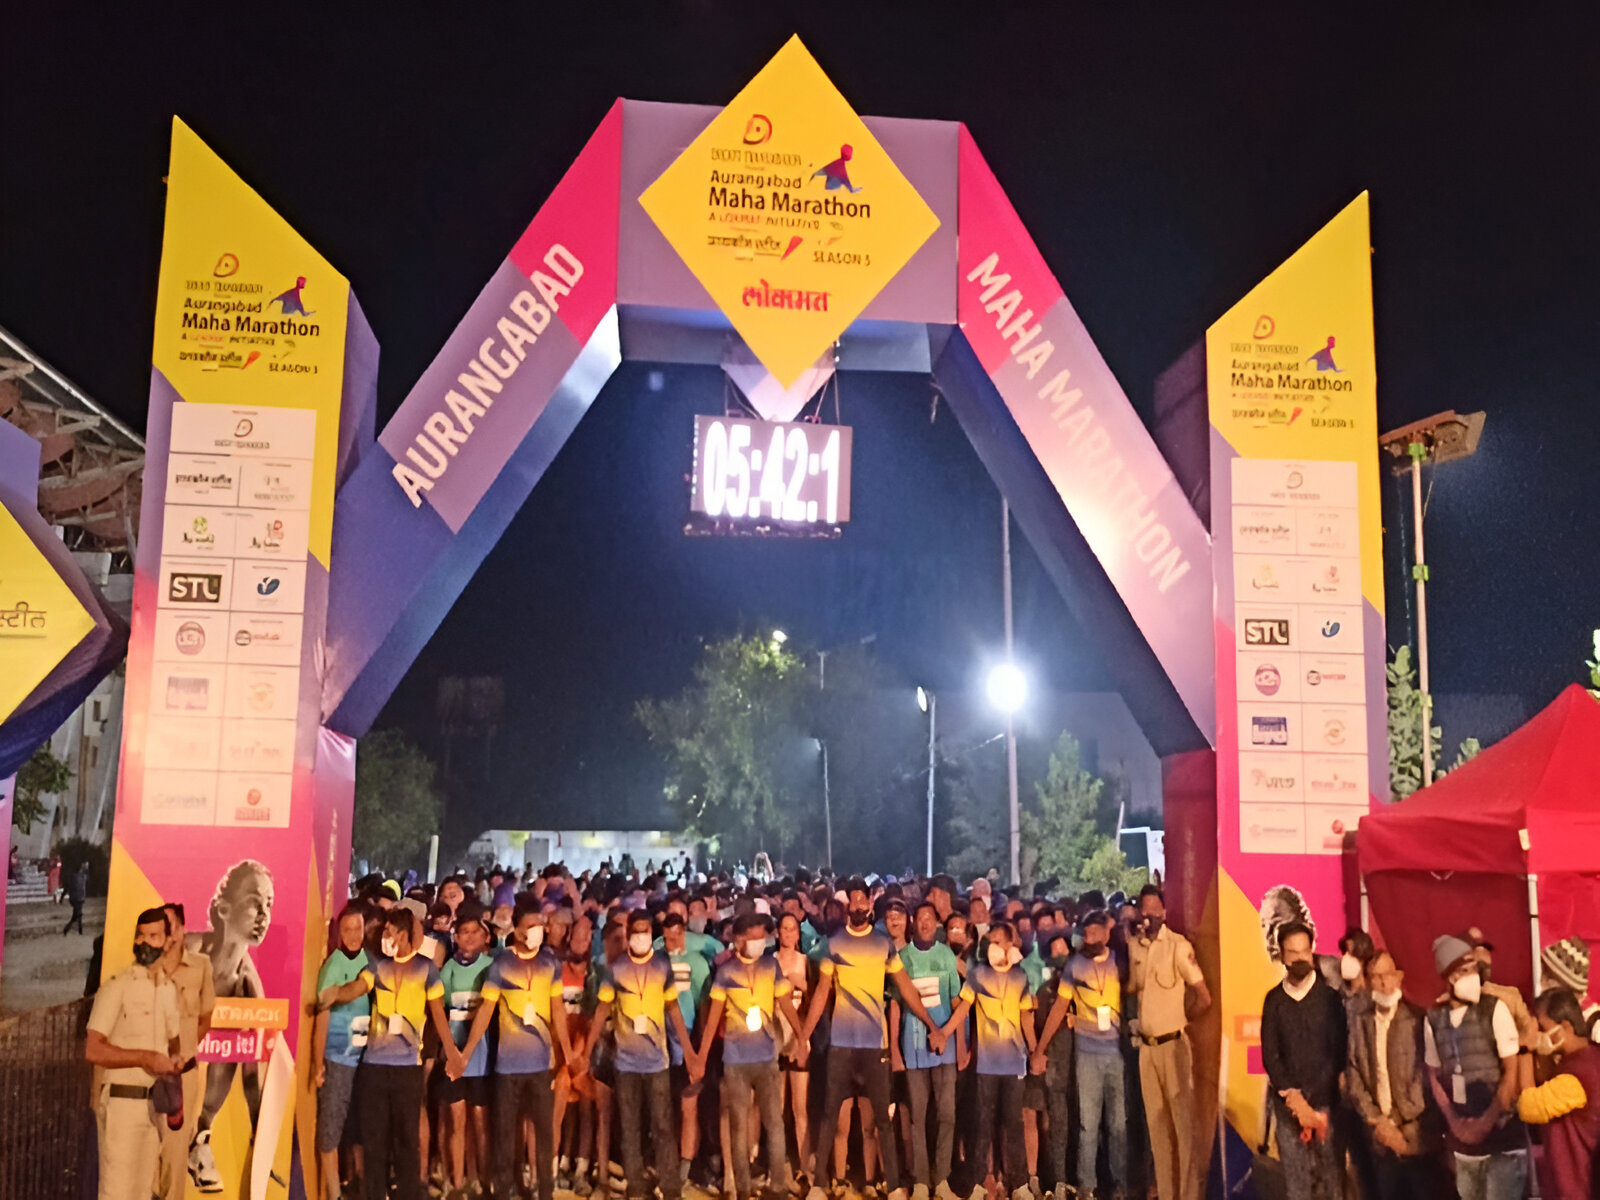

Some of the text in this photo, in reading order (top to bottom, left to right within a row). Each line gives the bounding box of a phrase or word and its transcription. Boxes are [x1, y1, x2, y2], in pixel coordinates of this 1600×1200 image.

[708, 187, 871, 218] Maha Marathon
[741, 278, 832, 312] लोकमत
[182, 312, 320, 337] Maha Marathon
[392, 243, 584, 508] AURANGABAD
[1230, 373, 1353, 392] Maha Marathon
[967, 251, 1191, 594] MAHA MARATHON
